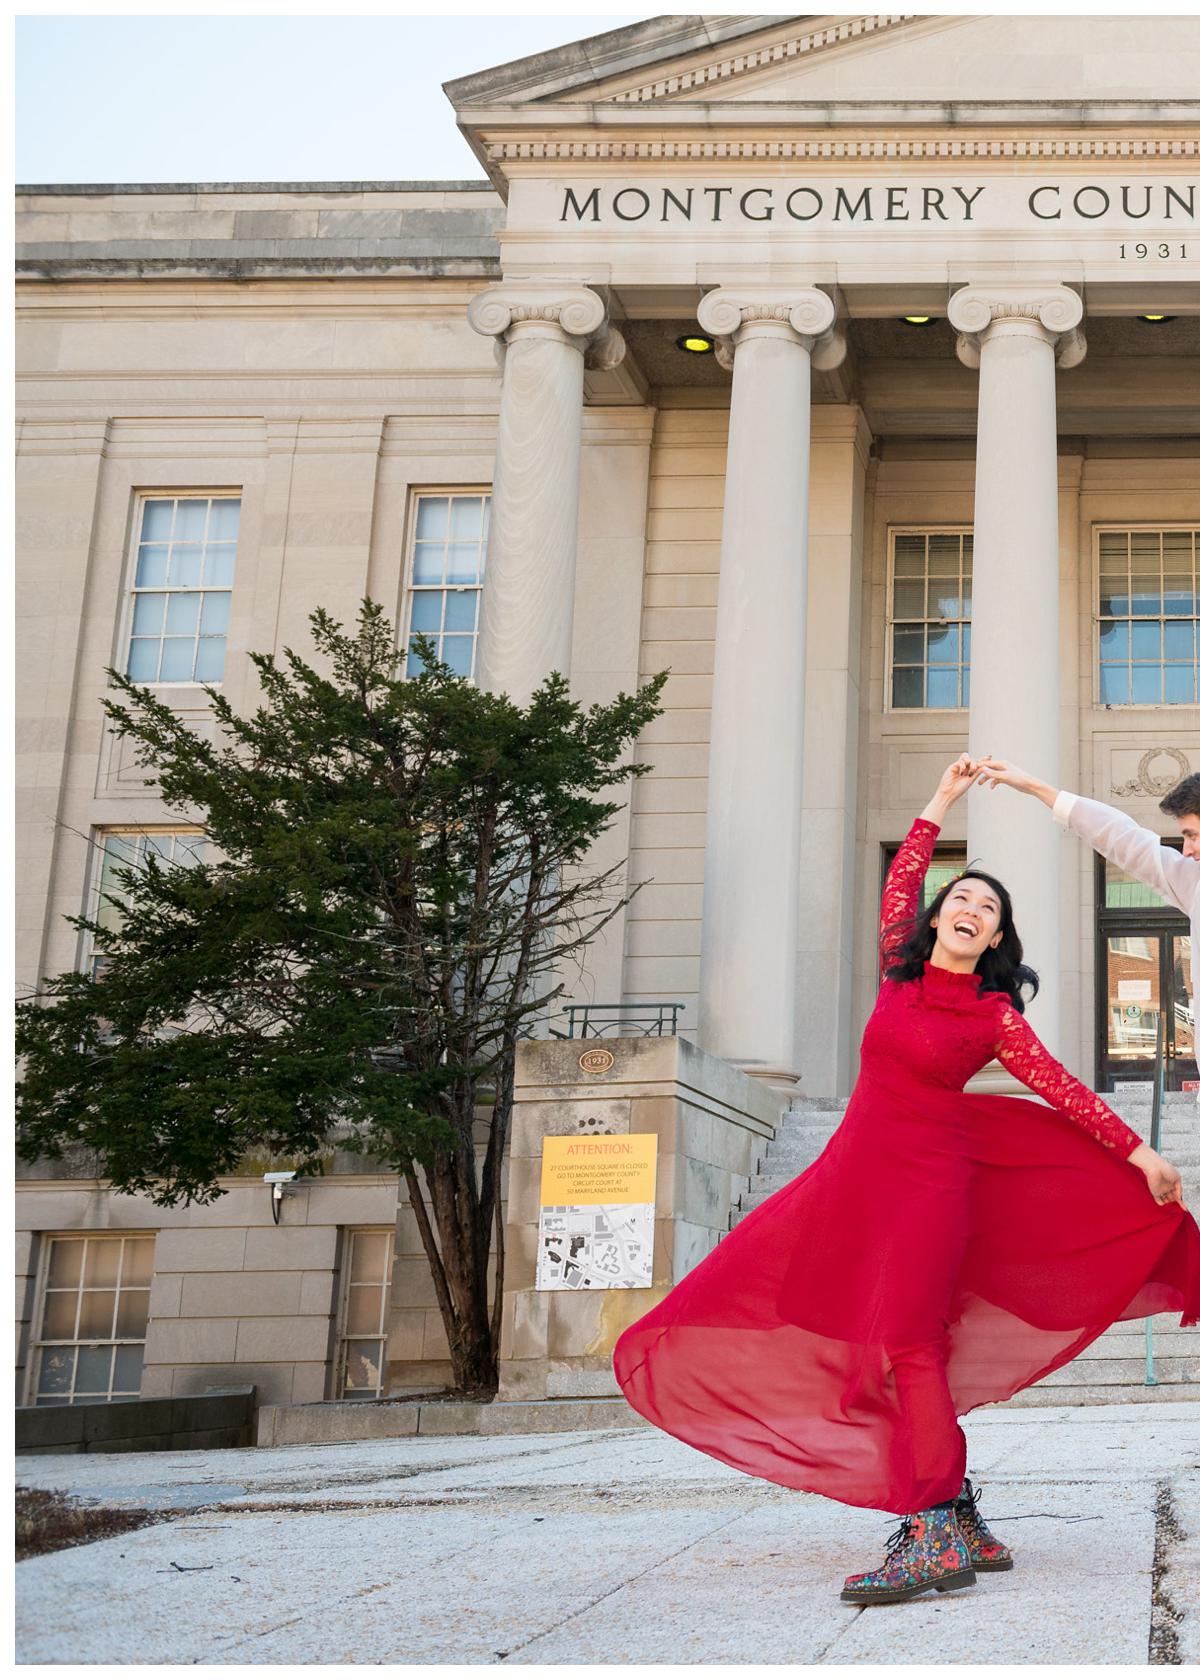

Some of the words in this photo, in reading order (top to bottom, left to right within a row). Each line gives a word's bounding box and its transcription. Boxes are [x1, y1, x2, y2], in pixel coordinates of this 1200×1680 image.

[560, 186, 983, 222] MONTGOMERY
[1118, 244, 1188, 259] 1931
[588, 1056, 606, 1065] 1931
[567, 1143, 633, 1155] ATTENTION:
